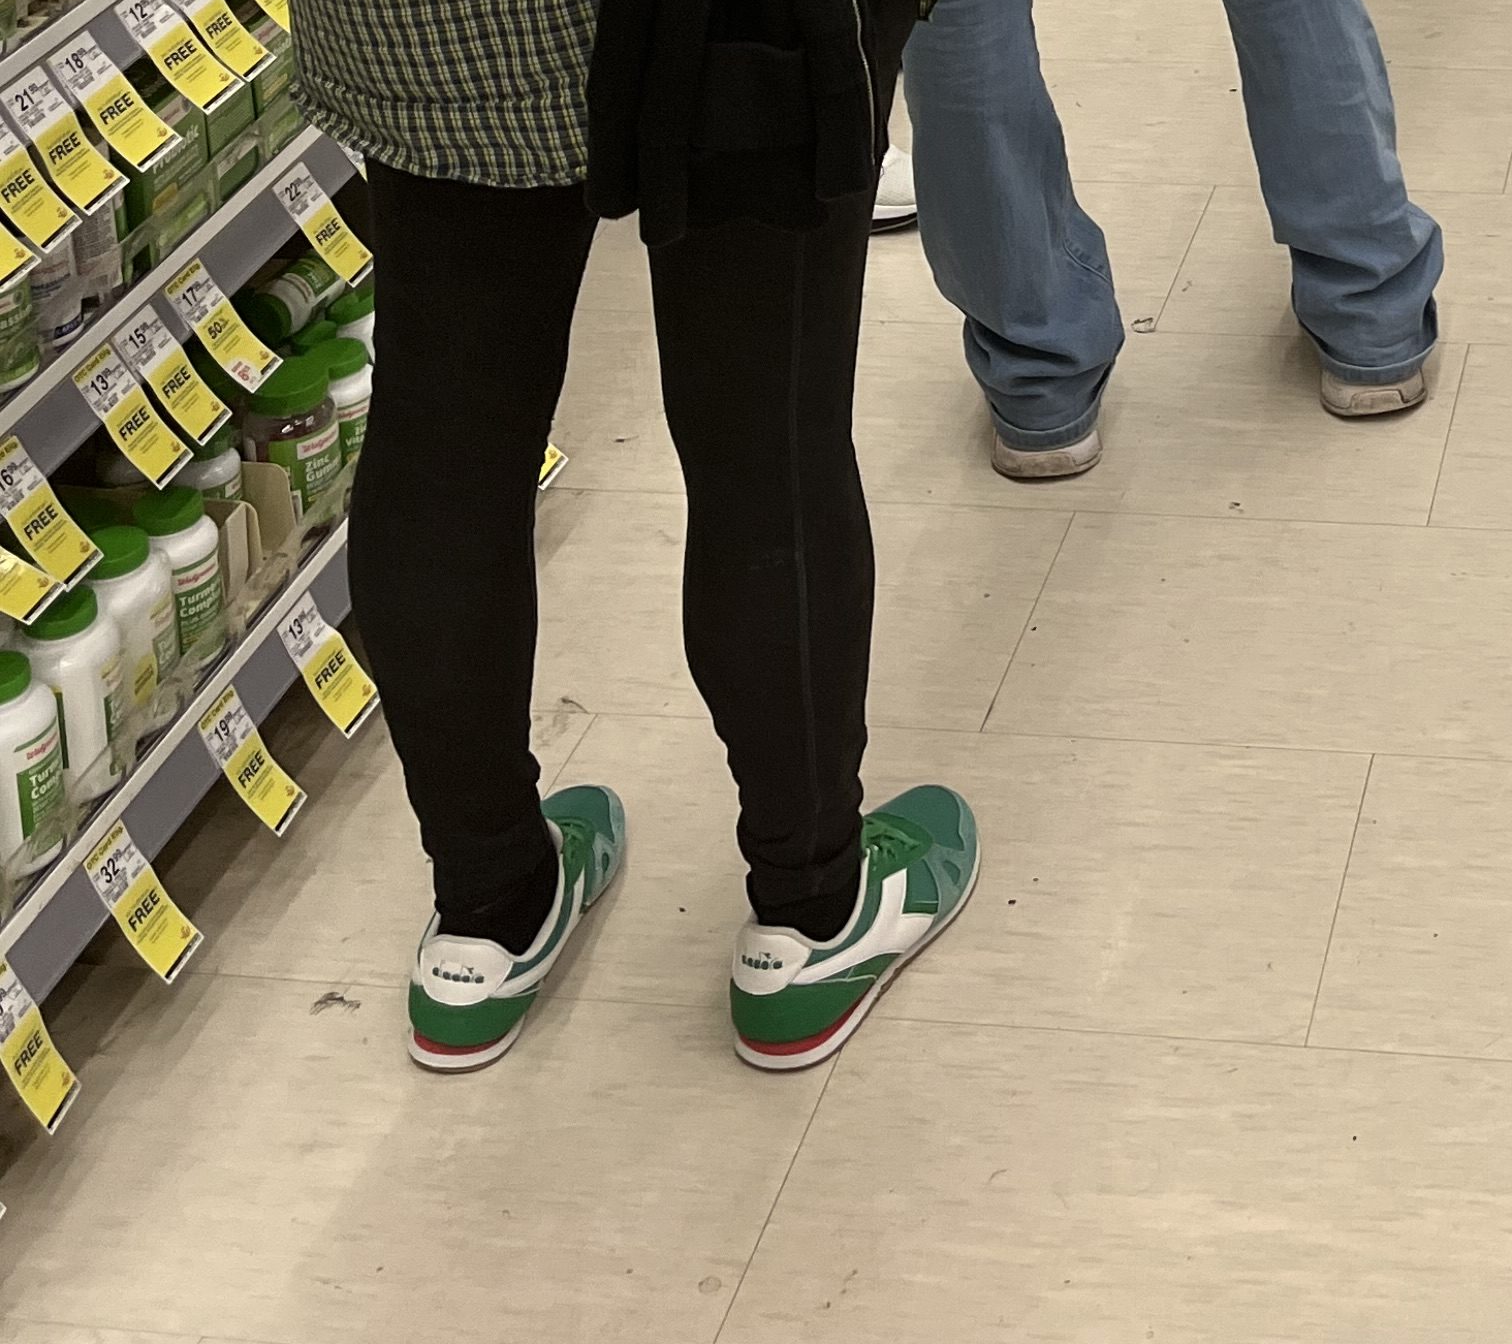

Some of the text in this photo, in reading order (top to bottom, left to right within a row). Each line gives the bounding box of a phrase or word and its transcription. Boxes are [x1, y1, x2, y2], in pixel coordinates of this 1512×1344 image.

[205, 11, 233, 39] FREE
[163, 38, 197, 71] FREE
[99, 91, 135, 126] FREE
[47, 133, 81, 165] FREE
[1, 168, 35, 204] FREE
[315, 216, 342, 247] FREE
[161, 364, 192, 399] FREE
[118, 405, 151, 443] FREE
[305, 453, 332, 473] Zinc
[23, 503, 60, 542] FREE
[314, 650, 347, 691] FREE
[237, 751, 266, 789] FREE
[128, 888, 162, 933] FREE
[14, 1031, 44, 1076] FREE
